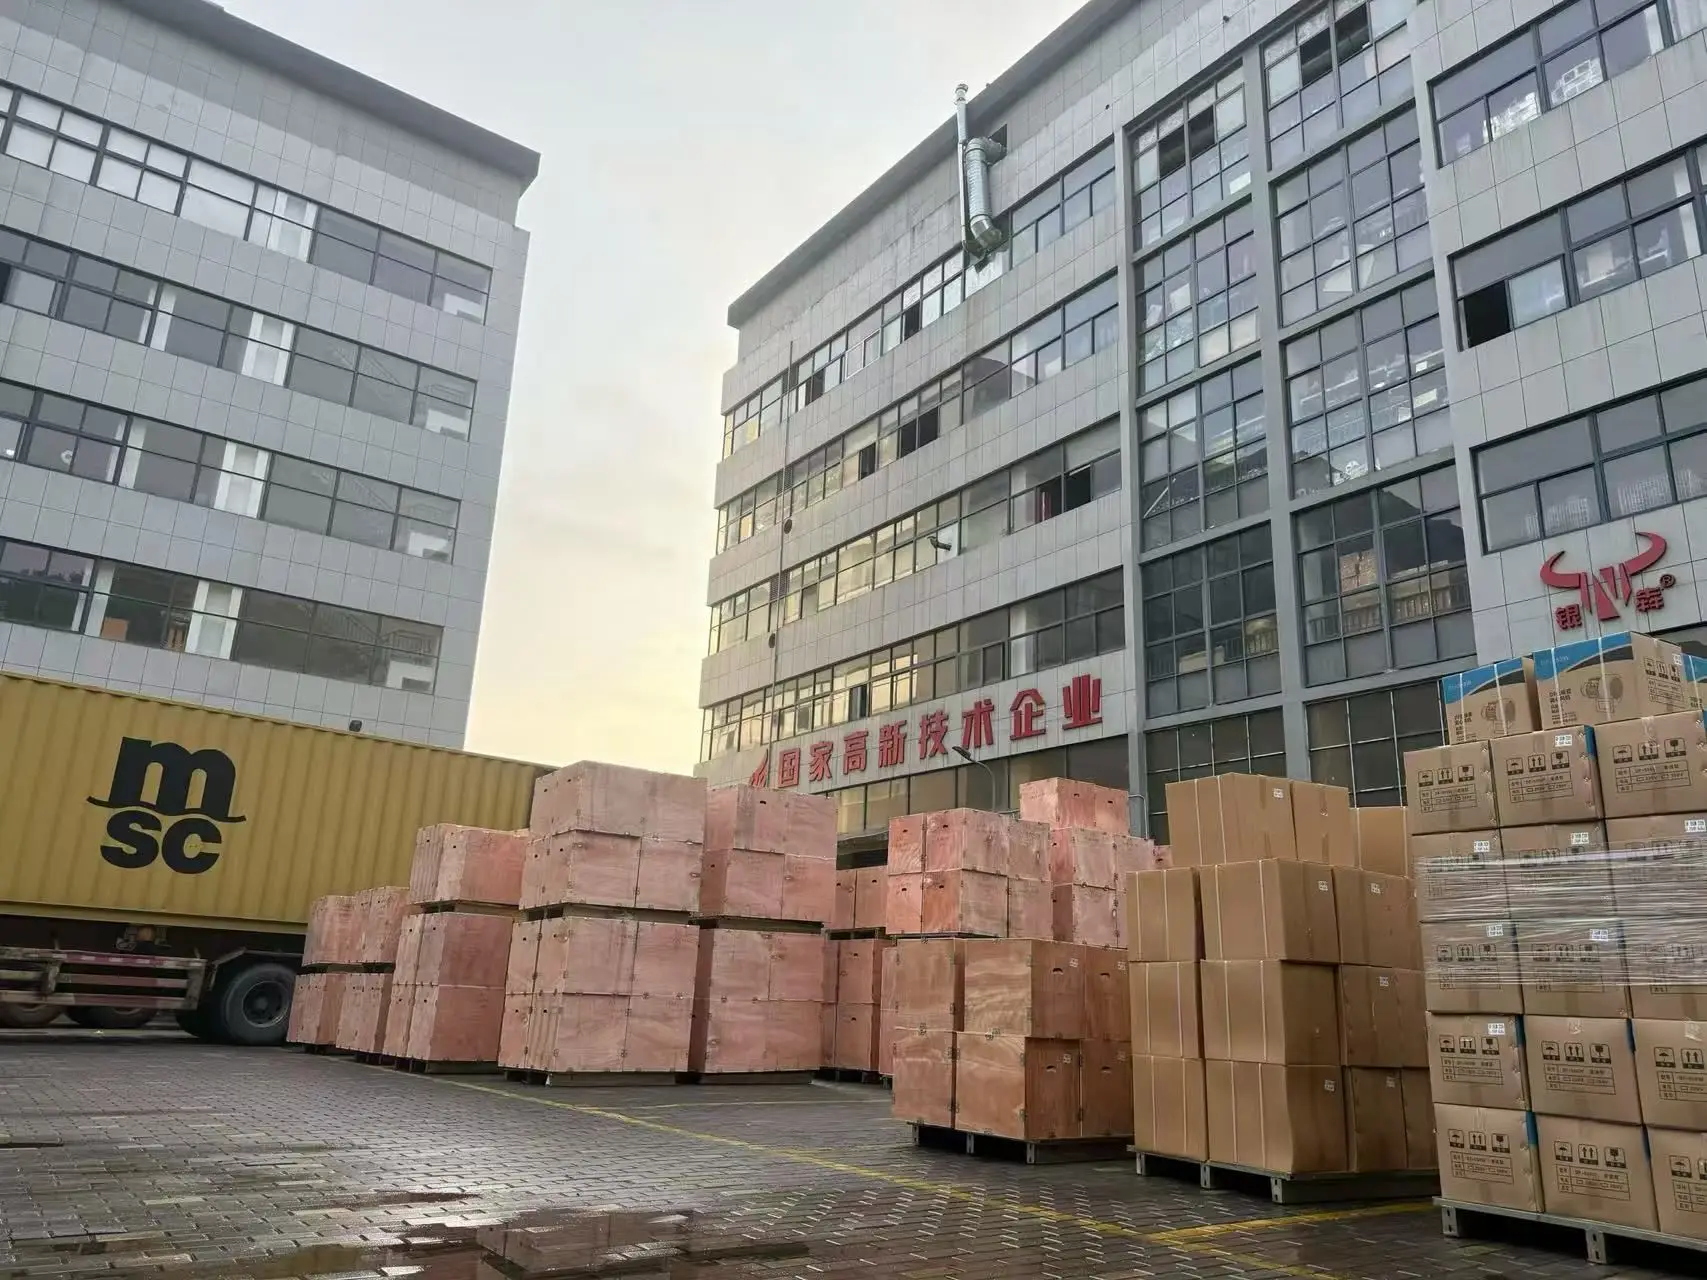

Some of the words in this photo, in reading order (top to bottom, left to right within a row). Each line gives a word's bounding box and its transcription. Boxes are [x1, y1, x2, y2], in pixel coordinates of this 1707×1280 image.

[778, 674, 1104, 788] 国家高新技术企业
